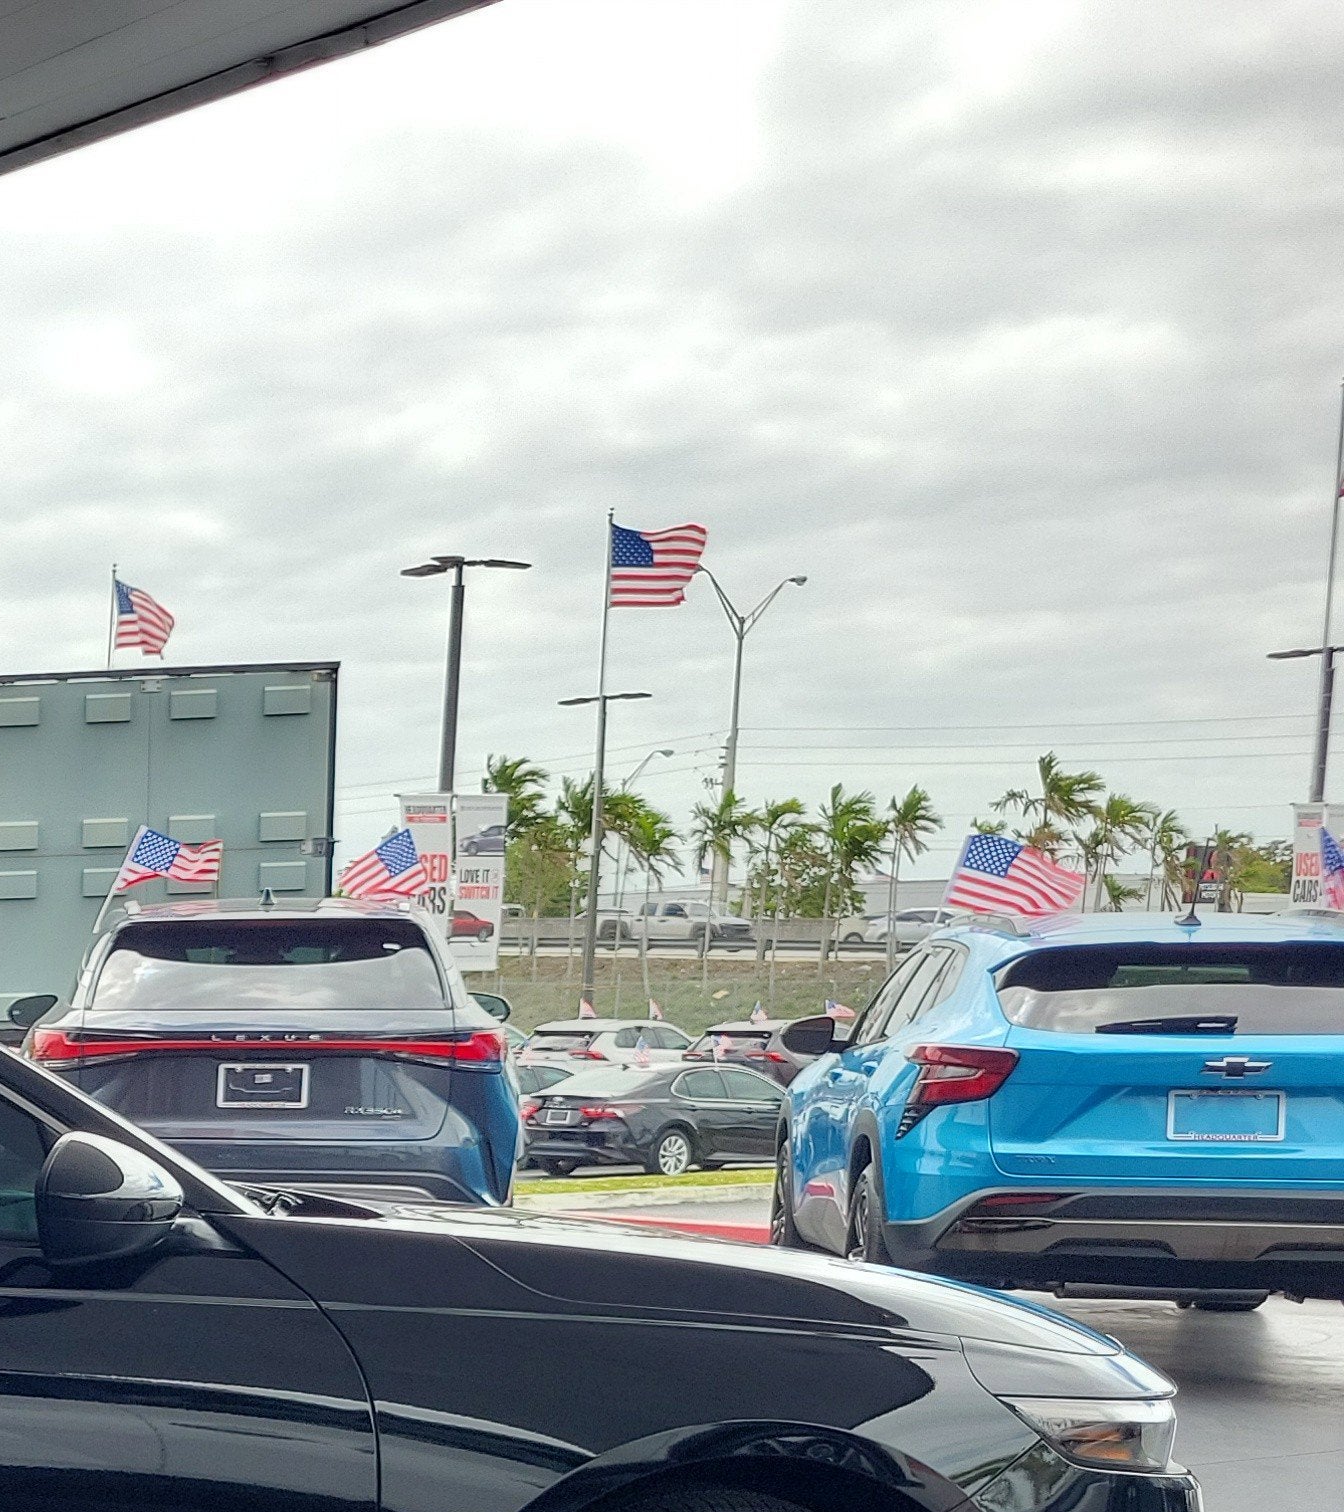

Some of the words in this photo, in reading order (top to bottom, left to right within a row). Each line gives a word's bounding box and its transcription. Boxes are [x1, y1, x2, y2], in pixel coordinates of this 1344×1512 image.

[419, 853, 448, 883] SED
[459, 868, 481, 883] LOVE
[211, 1034, 322, 1042] LEXUS
